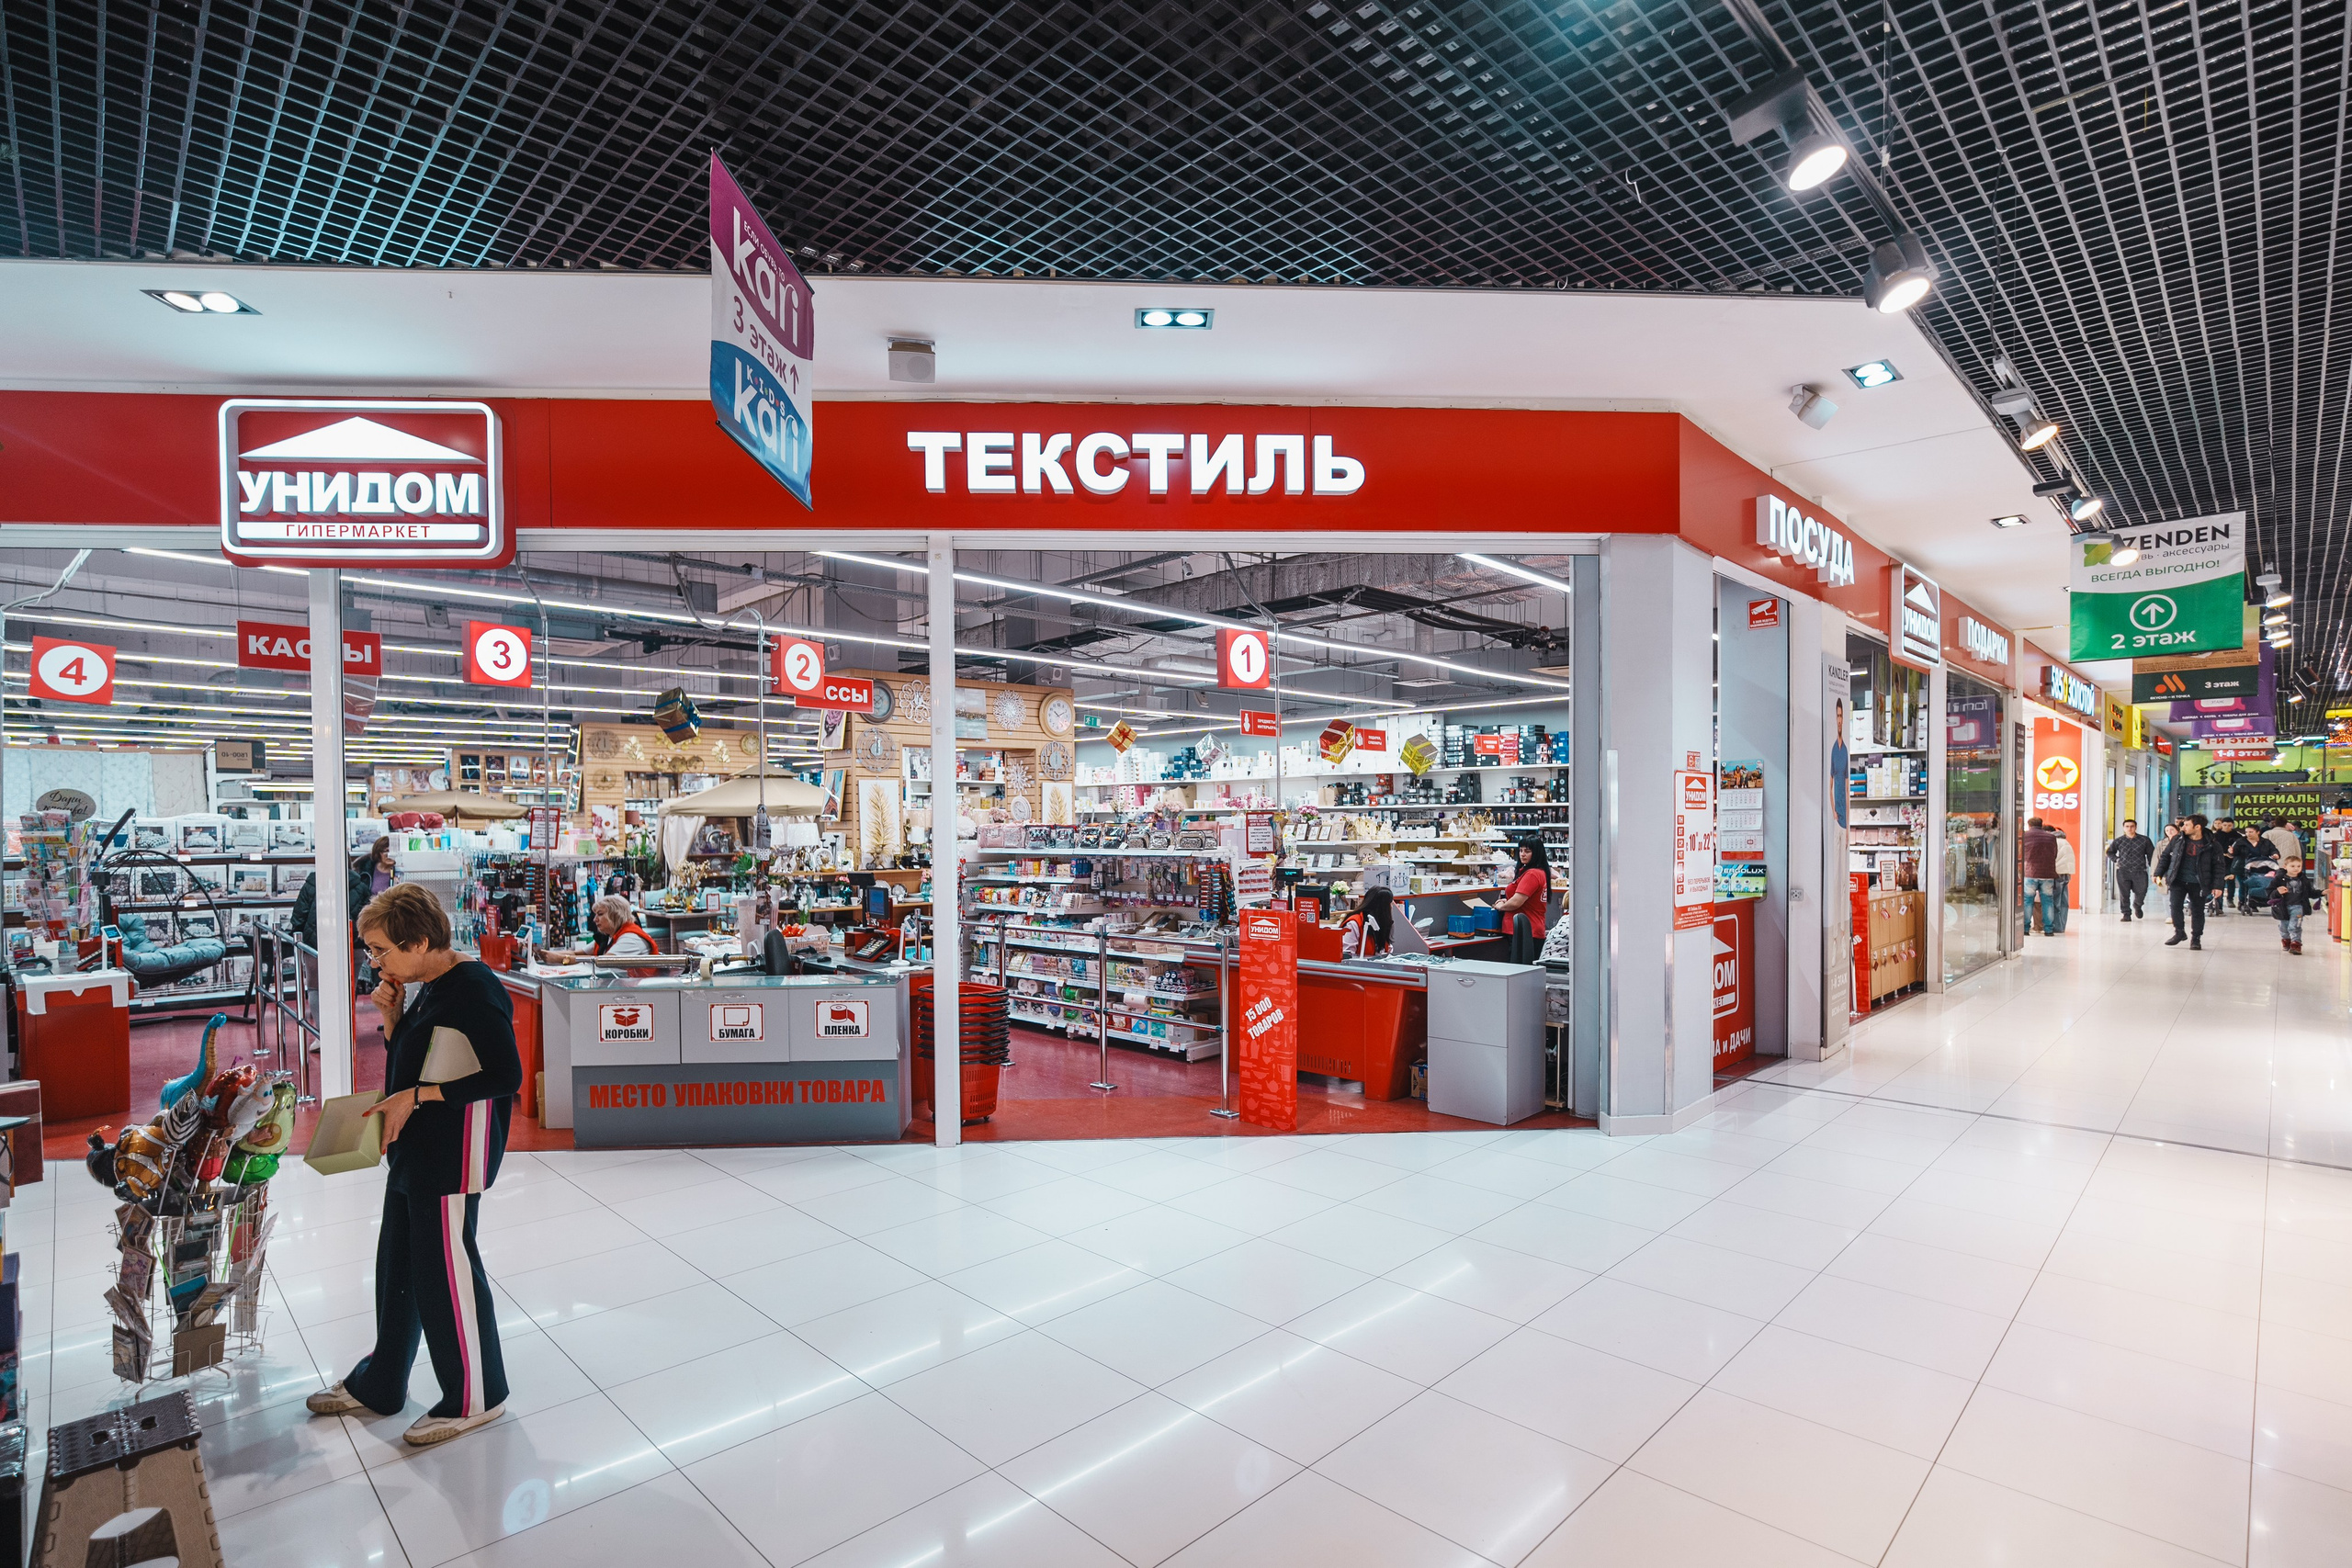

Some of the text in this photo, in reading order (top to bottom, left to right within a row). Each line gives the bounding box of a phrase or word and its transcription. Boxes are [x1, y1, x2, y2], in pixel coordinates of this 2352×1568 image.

[743, 220, 759, 247] ЕСЛИ
[733, 206, 799, 347] kari
[733, 295, 788, 385] 3 этаж
[734, 356, 798, 475] kari
[907, 432, 1366, 496] ТЕКСТИЛЬ
[237, 470, 481, 514] УНИДОМ
[286, 524, 431, 538] ГИПЕРМАРКЕТ
[1769, 494, 1855, 587] ПОСУДА
[2123, 524, 2230, 550] ZENDEN
[2163, 543, 2230, 558] аксессуары
[2091, 559, 2220, 582] ВСЕГДА ВЫГОДНО!
[1904, 606, 1939, 646] УНИДОМ
[2110, 630, 2197, 649] 2 этаж
[248, 635, 372, 663] КАСЫ
[1967, 616, 2007, 665] ПОДАРКИ
[492, 640, 513, 670] 3
[796, 653, 811, 682] 2
[1240, 645, 1253, 673] 1
[58, 657, 88, 686] 4
[1828, 664, 1849, 682] KANZLER
[2051, 665, 2064, 701] 585
[824, 685, 868, 705] ССЫ
[1686, 791, 1706, 802] УНИДОМ
[2035, 793, 2078, 809] 585
[2235, 807, 2320, 817] КСЕССУАРЫ
[1250, 926, 1279, 934] УНИДОМ
[1245, 997, 1272, 1022] 15 000
[605, 1028, 649, 1039] КОРОБКИ
[718, 1028, 755, 1039] БУМАГА
[824, 1025, 861, 1036] ПЛЕНКА
[1247, 1008, 1284, 1040] ТОВАРОВ
[1729, 1027, 1751, 1054] ДАЧИ
[589, 1079, 886, 1109] МЕСТО УПАКОВКИ ТОВАРА
